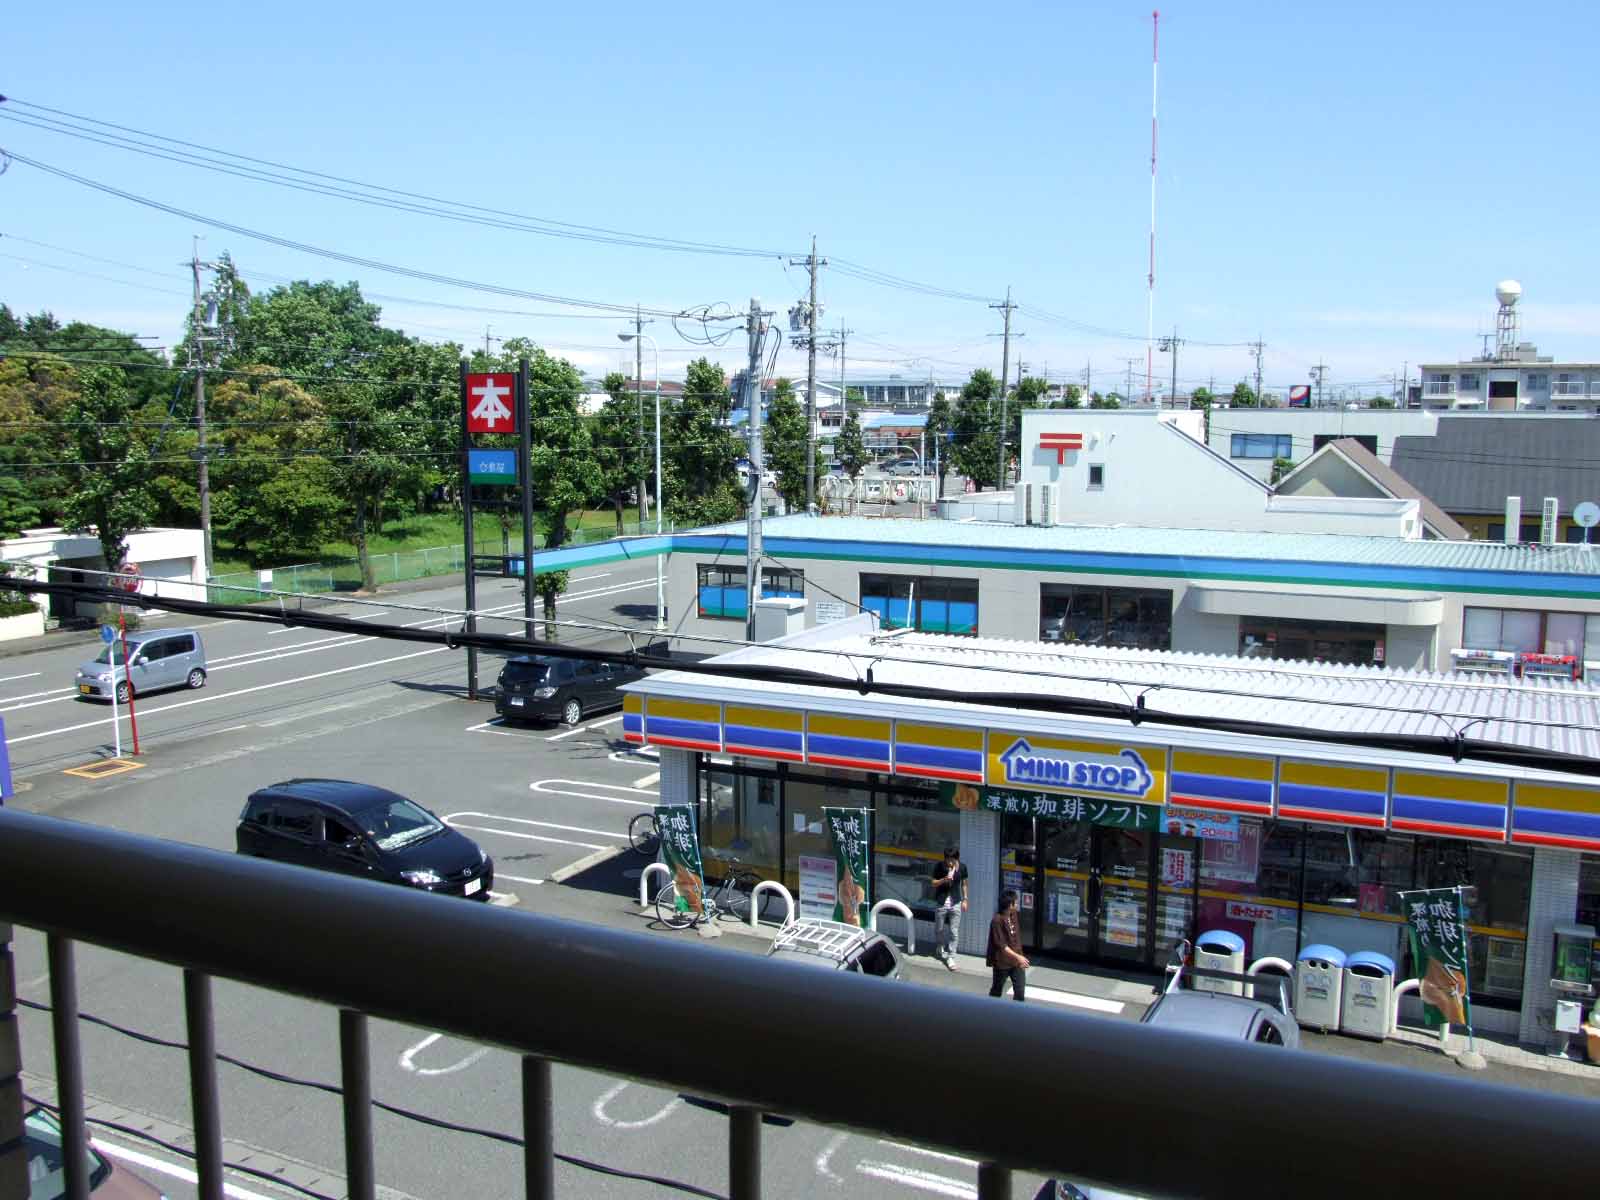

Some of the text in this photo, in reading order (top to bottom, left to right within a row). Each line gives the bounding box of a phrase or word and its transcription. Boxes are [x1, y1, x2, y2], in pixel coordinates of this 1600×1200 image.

[471, 378, 511, 428] 本
[1015, 756, 1137, 788] MINI STOP
[986, 794, 1148, 828] 深煎り珈琲ソフト
